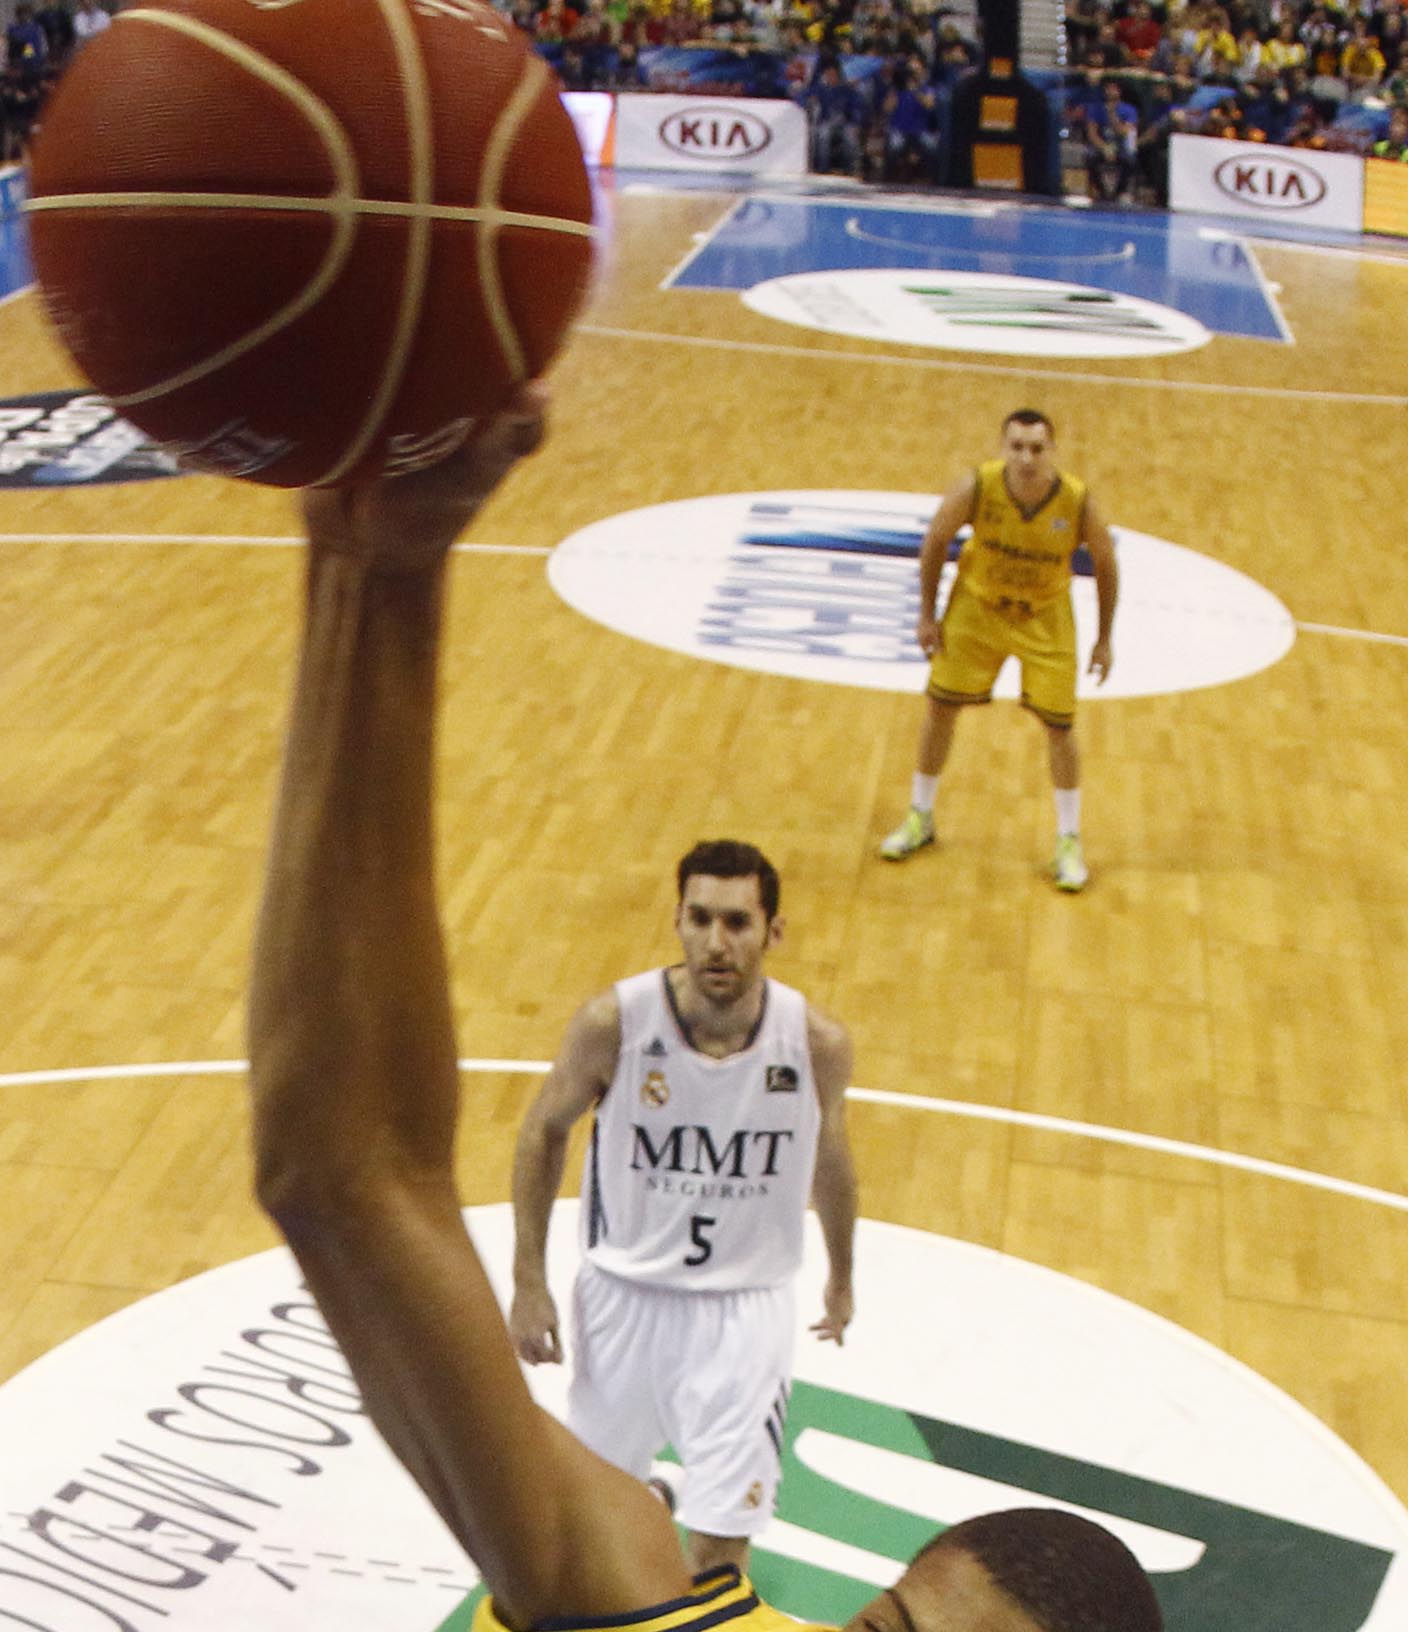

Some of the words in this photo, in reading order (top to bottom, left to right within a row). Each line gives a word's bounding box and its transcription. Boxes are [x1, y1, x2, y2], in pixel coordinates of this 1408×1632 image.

[678, 119, 752, 148] KIA
[1232, 164, 1306, 200] KIA
[629, 1122, 794, 1178] MMT
[645, 1176, 770, 1199] SEGUROS
[683, 1214, 717, 1267] 5
